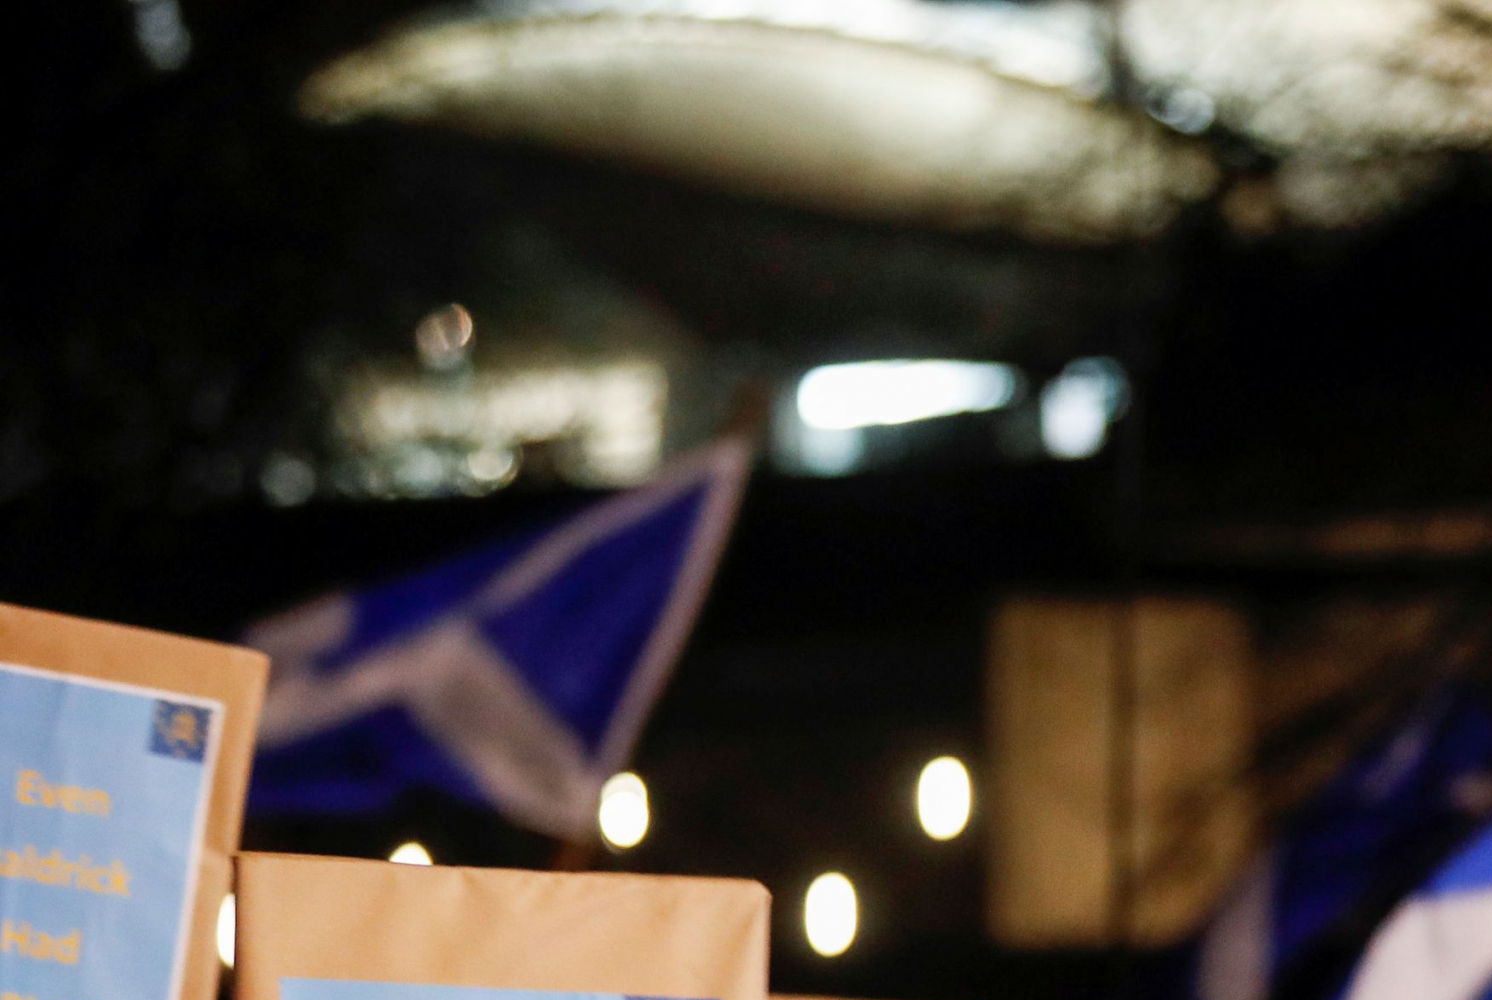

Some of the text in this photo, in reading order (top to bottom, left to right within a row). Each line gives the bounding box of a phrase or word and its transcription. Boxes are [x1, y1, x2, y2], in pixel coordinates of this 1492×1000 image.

[15, 767, 112, 817] Even
[0, 845, 132, 898] aldrick
[0, 919, 83, 965] Had
